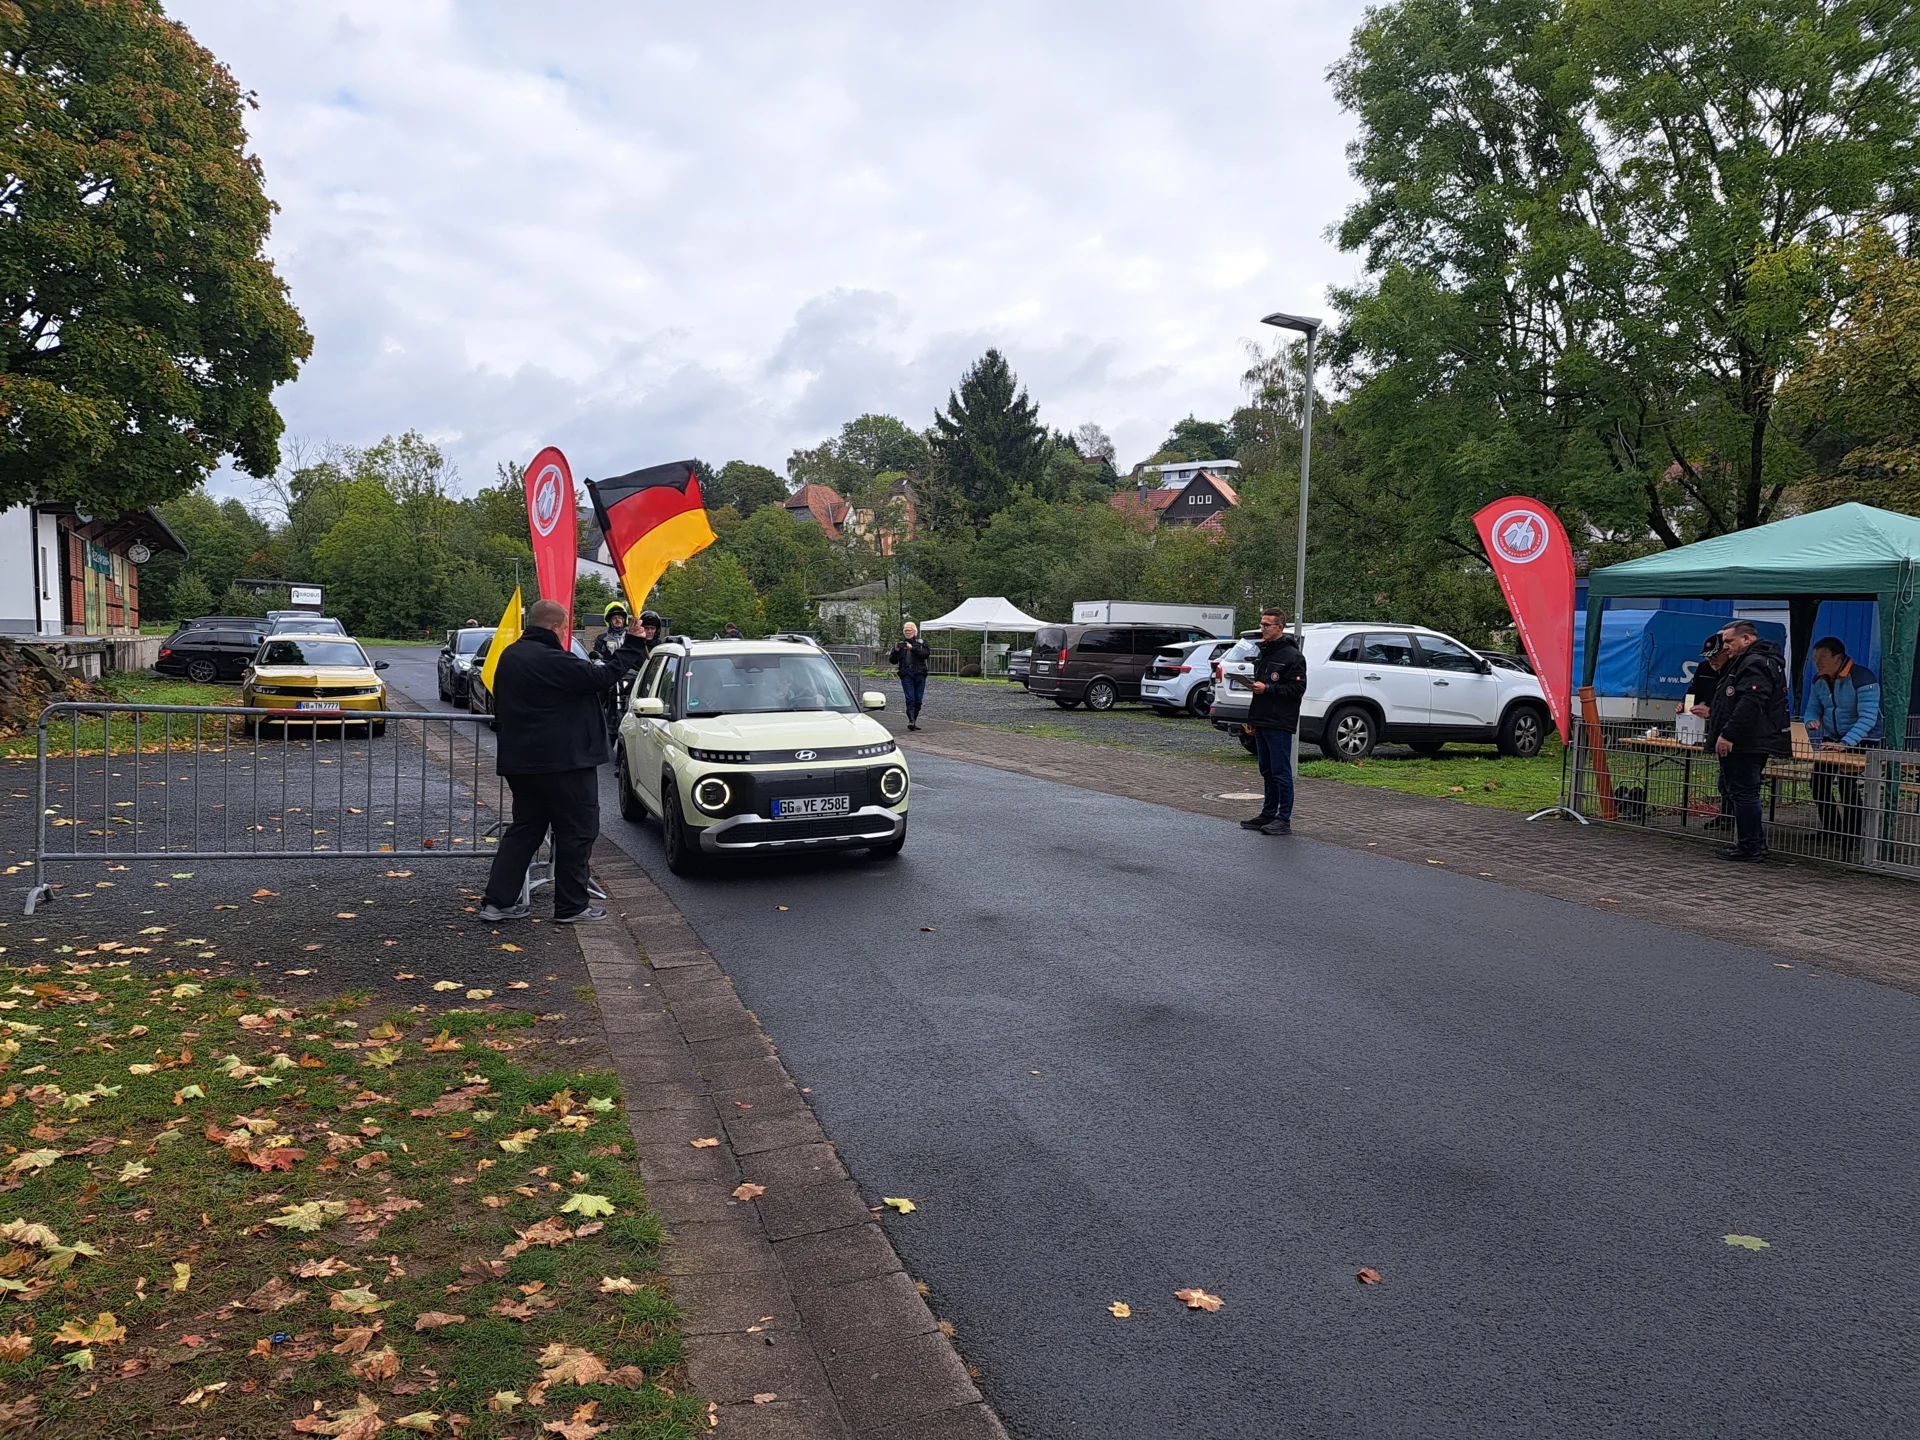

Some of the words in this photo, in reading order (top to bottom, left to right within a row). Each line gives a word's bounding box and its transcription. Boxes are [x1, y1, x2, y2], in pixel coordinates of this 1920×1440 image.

[780, 801, 795, 814] GG
[803, 799, 817, 812] YE
[820, 797, 848, 811] 258E
